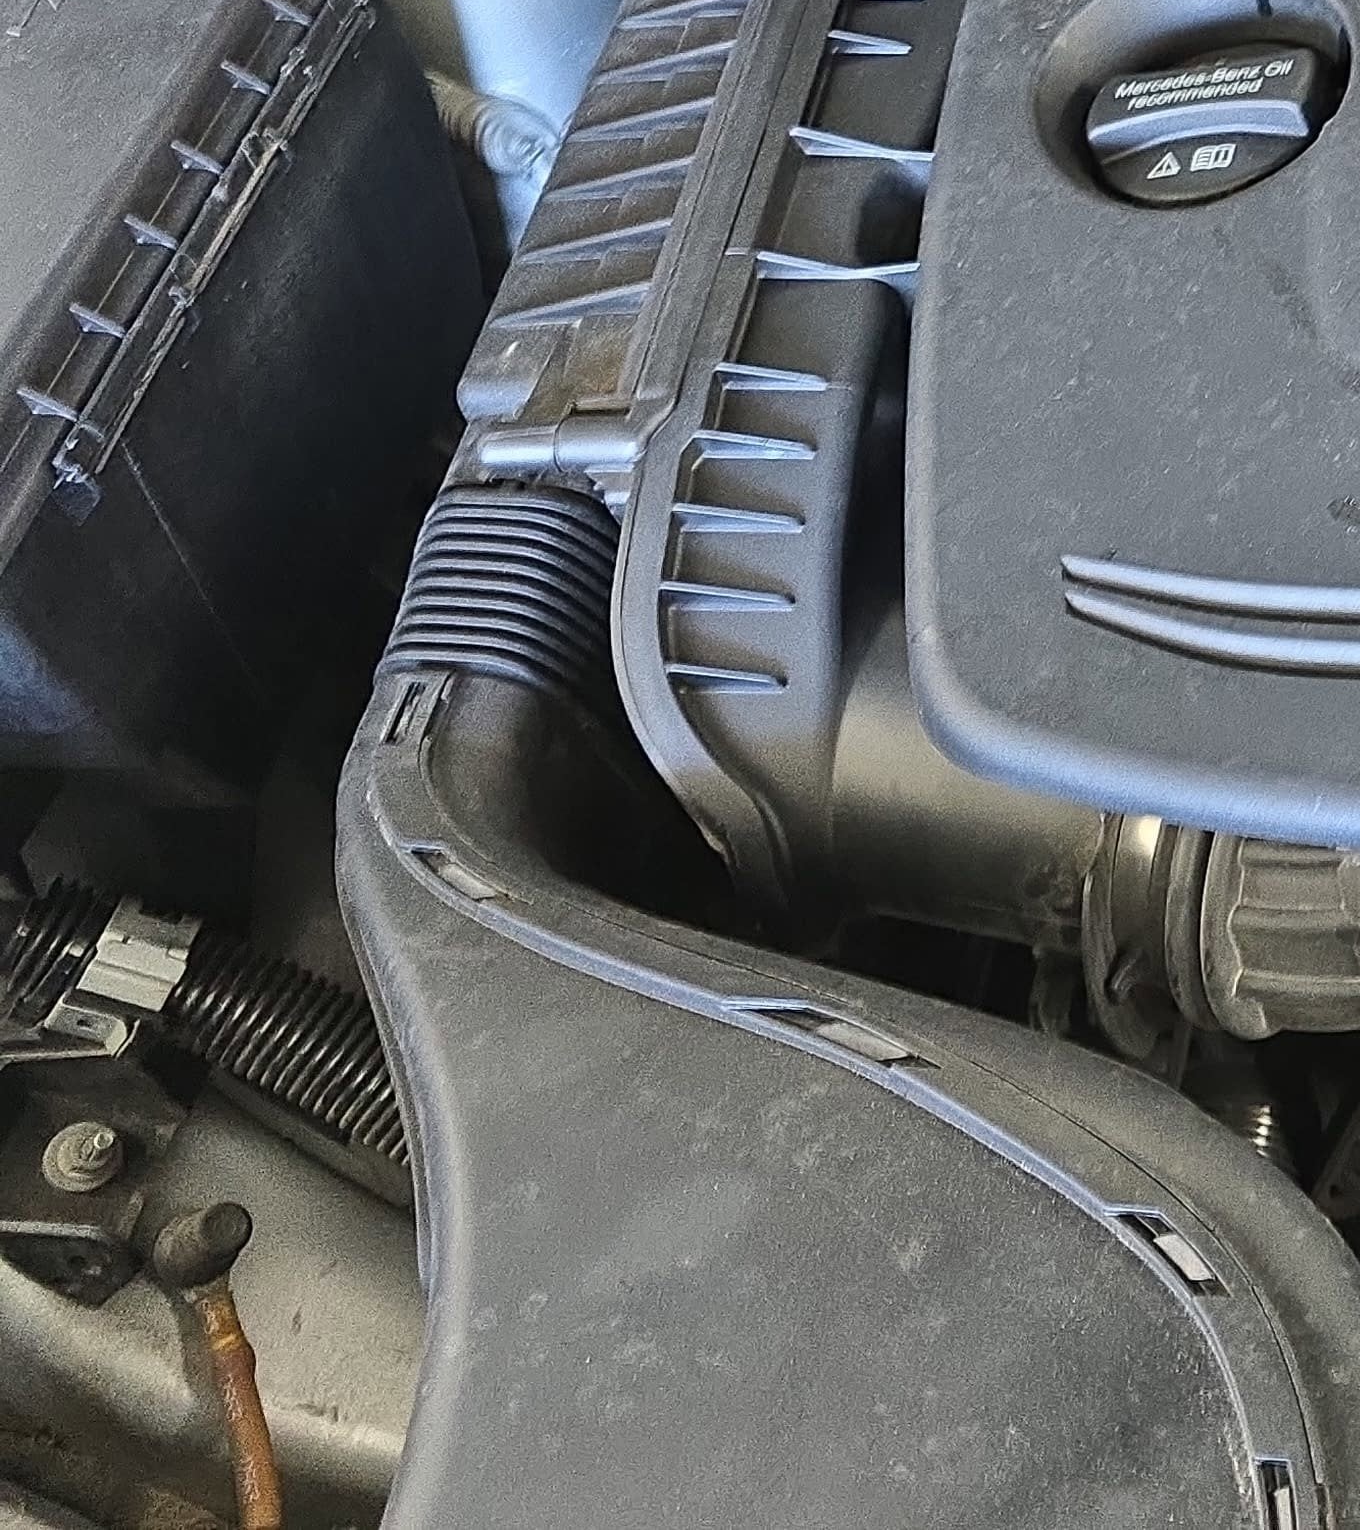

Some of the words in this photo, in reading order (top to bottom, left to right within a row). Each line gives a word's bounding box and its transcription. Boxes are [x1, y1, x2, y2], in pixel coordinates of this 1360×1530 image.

[1114, 65, 1263, 99] Mercedes-Benz
[1264, 59, 1294, 78] Oil
[1127, 77, 1264, 111] recommended
